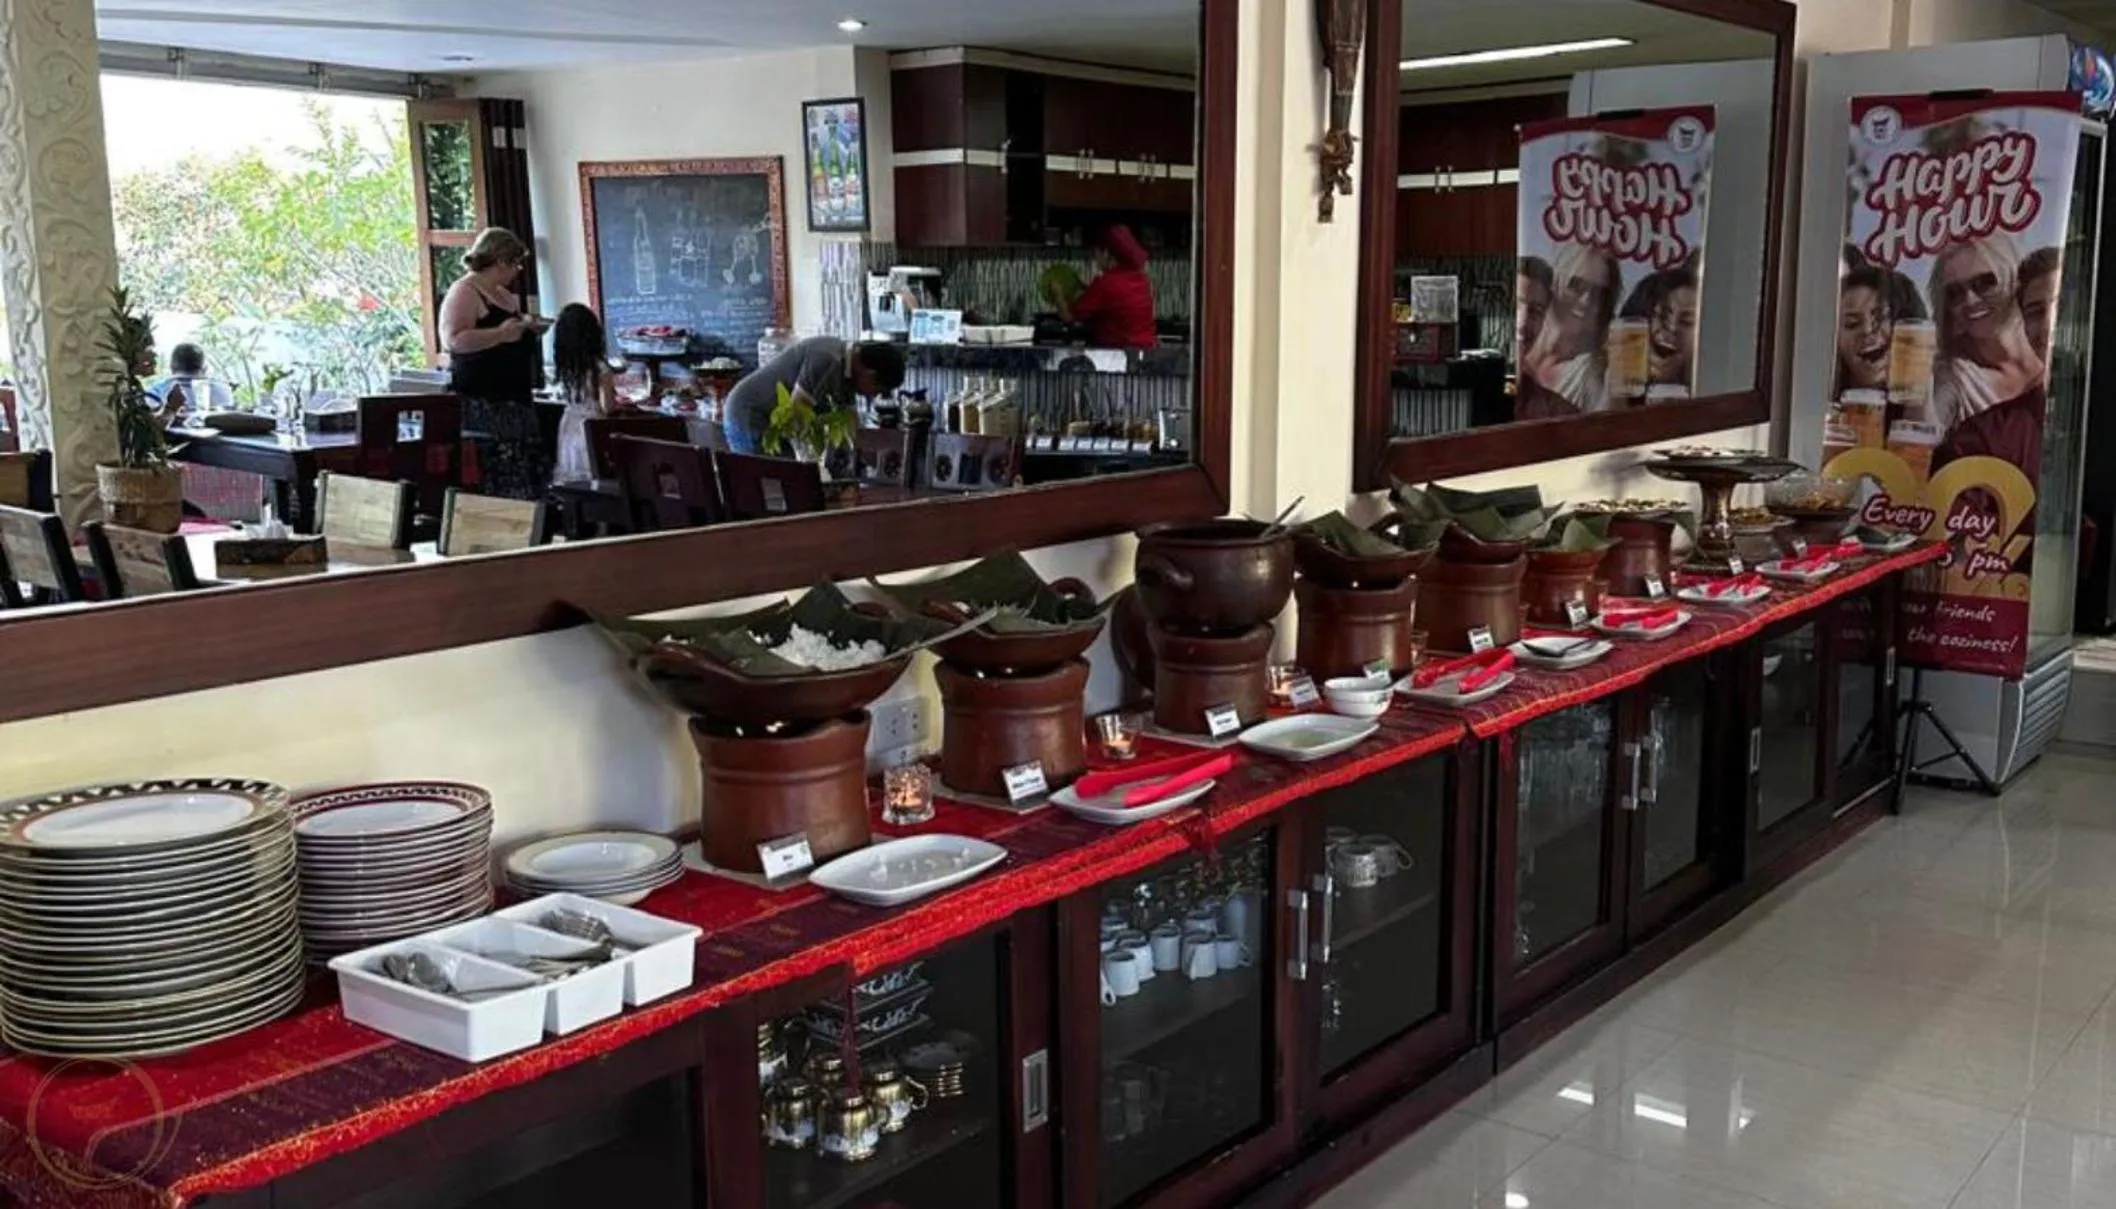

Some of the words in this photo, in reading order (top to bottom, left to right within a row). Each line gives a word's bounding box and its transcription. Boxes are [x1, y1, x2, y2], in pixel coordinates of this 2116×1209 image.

[1870, 136, 2027, 208] Happy
[1870, 184, 2032, 263] Hour
[1864, 498, 1932, 531] Every
[1947, 505, 1996, 538] day
[1966, 552, 2009, 577] pm
[1935, 600, 1997, 622] friends
[1907, 626, 1937, 643] the
